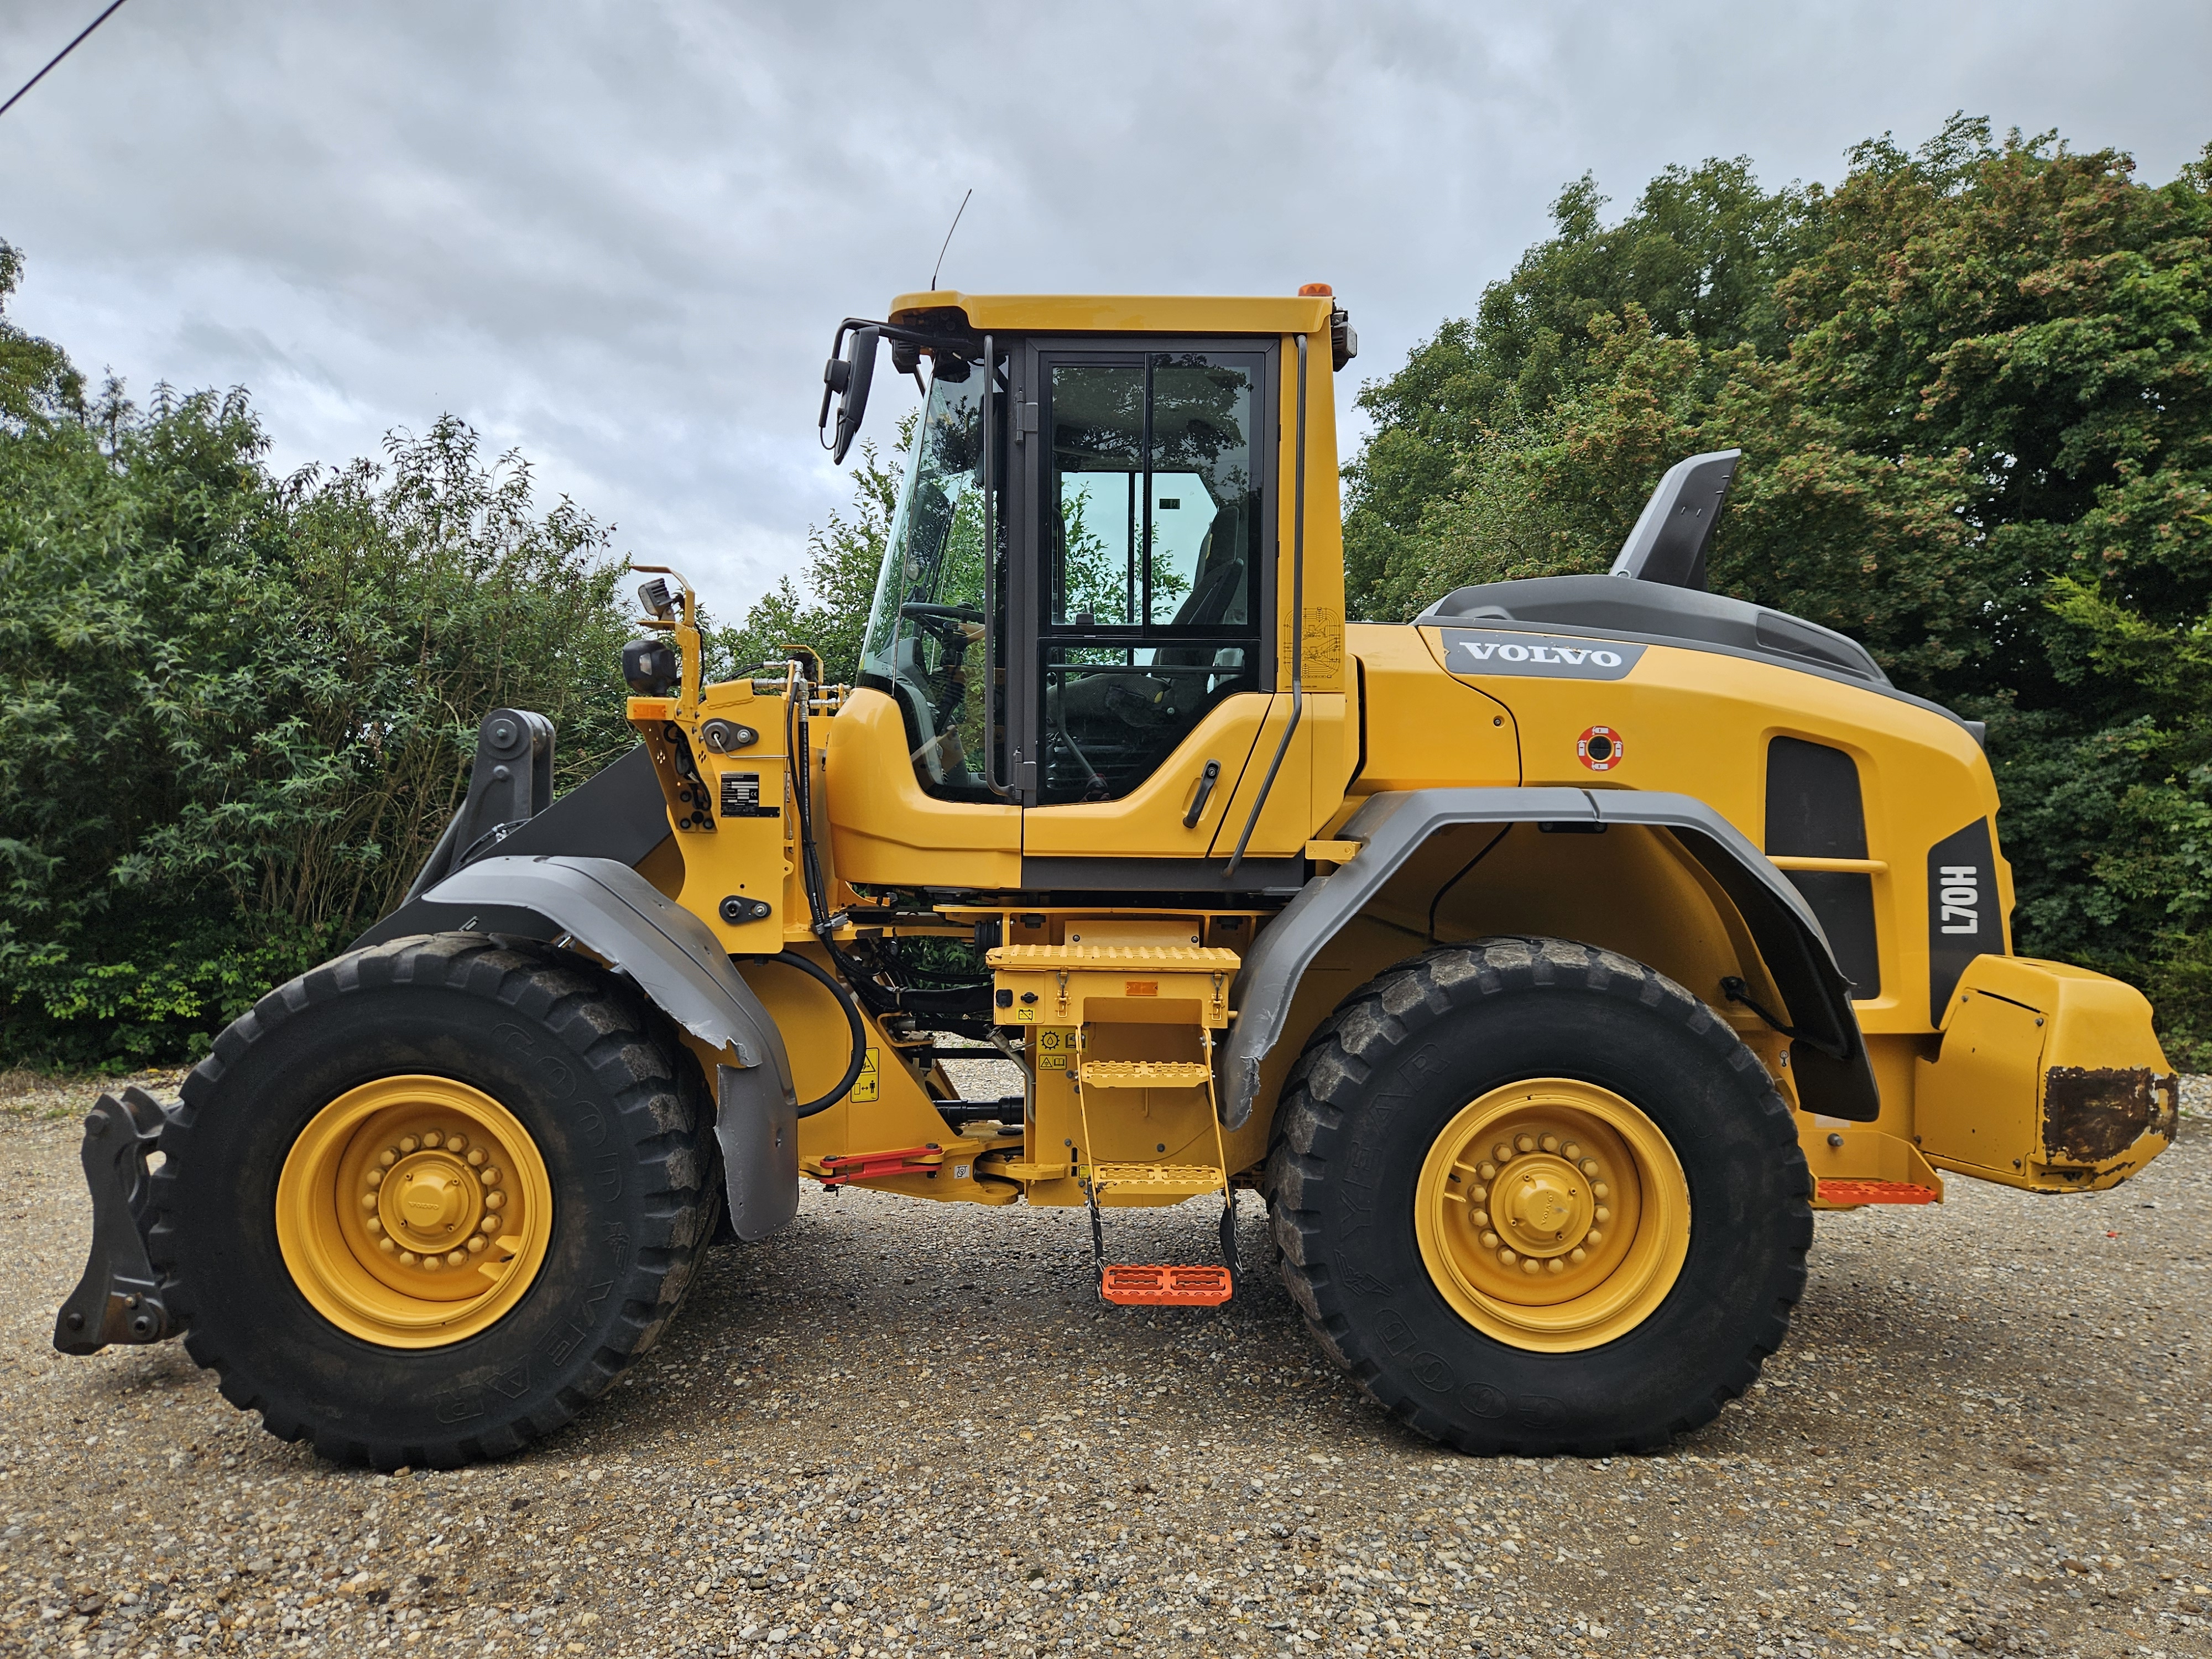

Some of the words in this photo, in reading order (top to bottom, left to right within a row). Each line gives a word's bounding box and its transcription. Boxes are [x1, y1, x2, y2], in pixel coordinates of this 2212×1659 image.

[1459, 641, 1622, 667] VOLVO
[1940, 866, 1978, 934] L70H
[408, 1201, 439, 1210] VOLVO
